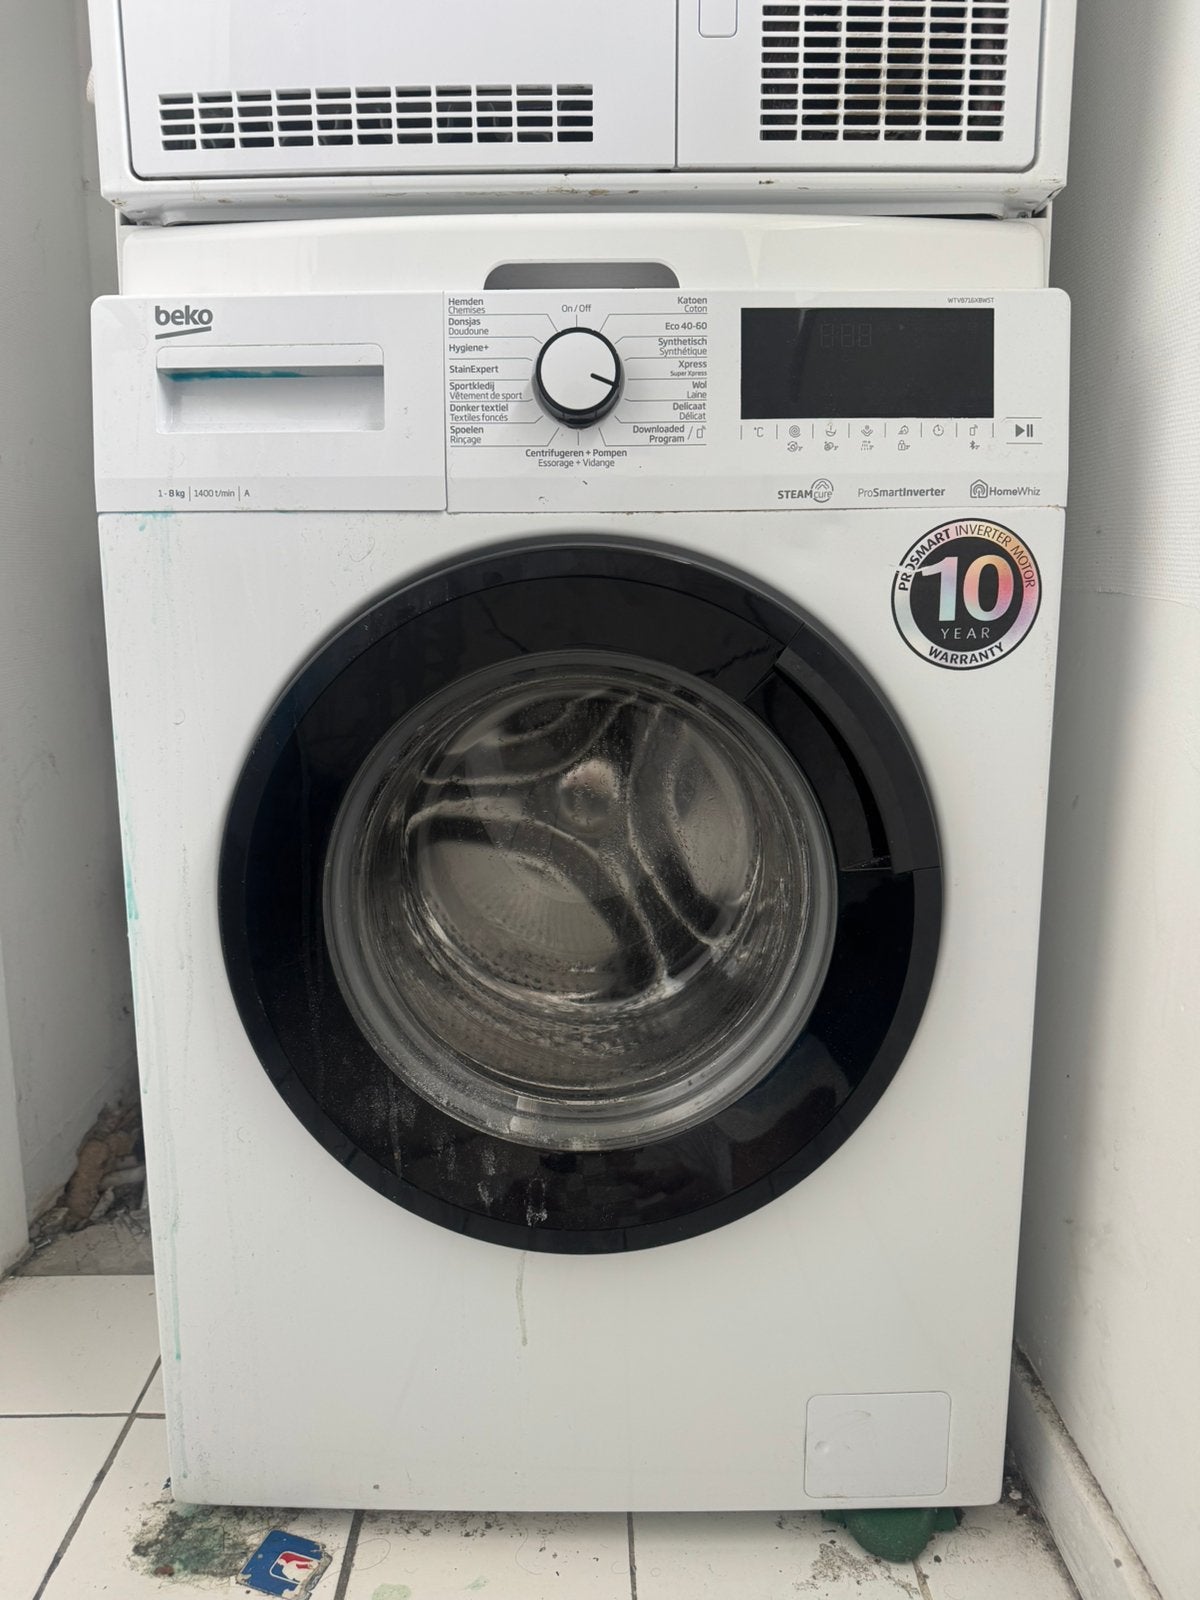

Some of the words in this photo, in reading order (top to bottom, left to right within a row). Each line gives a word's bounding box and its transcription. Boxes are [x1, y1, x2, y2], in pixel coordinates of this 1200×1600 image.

[448, 297, 484, 306] Hemden
[677, 296, 708, 305] Katoen
[448, 305, 486, 315] Chemises
[684, 304, 708, 313] Coton
[154, 305, 214, 326] beko
[448, 317, 481, 327] Donsjas
[665, 322, 680, 330] Eco
[681, 322, 708, 330] 40-60
[448, 327, 489, 336] Doudoune
[658, 337, 708, 347] Synthetisch
[448, 343, 489, 353] Hygiene+
[659, 346, 708, 356] Synthétique
[449, 364, 499, 375] StainExpert
[678, 360, 708, 369] Xpress
[449, 382, 495, 391] Sportkledij
[692, 380, 708, 389] Wol
[449, 391, 488, 400] Vêtement
[490, 391, 500, 400] de
[501, 391, 523, 401] sport
[687, 390, 708, 399] Laine
[449, 403, 479, 412] Donker
[480, 403, 509, 412] textiel
[672, 402, 706, 411] Delicaat
[450, 413, 480, 422] Textiles
[481, 412, 509, 422] foncés
[679, 411, 706, 420] Délicat
[450, 425, 484, 435] Spoelen
[632, 424, 685, 434] Downloaded
[450, 435, 482, 445] Rinçage
[649, 434, 685, 444] Program
[525, 448, 584, 459] Centrifugeren
[592, 449, 627, 459] Pompen
[538, 458, 574, 468] Essorage
[582, 458, 615, 468] Vidange
[194, 489, 214, 498] 1400
[244, 489, 250, 497] A
[858, 487, 946, 498] ProSmartInverter
[989, 486, 1041, 497] HomeWhiz
[955, 524, 1013, 547] INVERTER
[1010, 545, 1036, 588] MOTOR
[922, 554, 1015, 622] 10
[941, 627, 992, 640] YEAR
[928, 641, 1004, 665] WARRANTY
